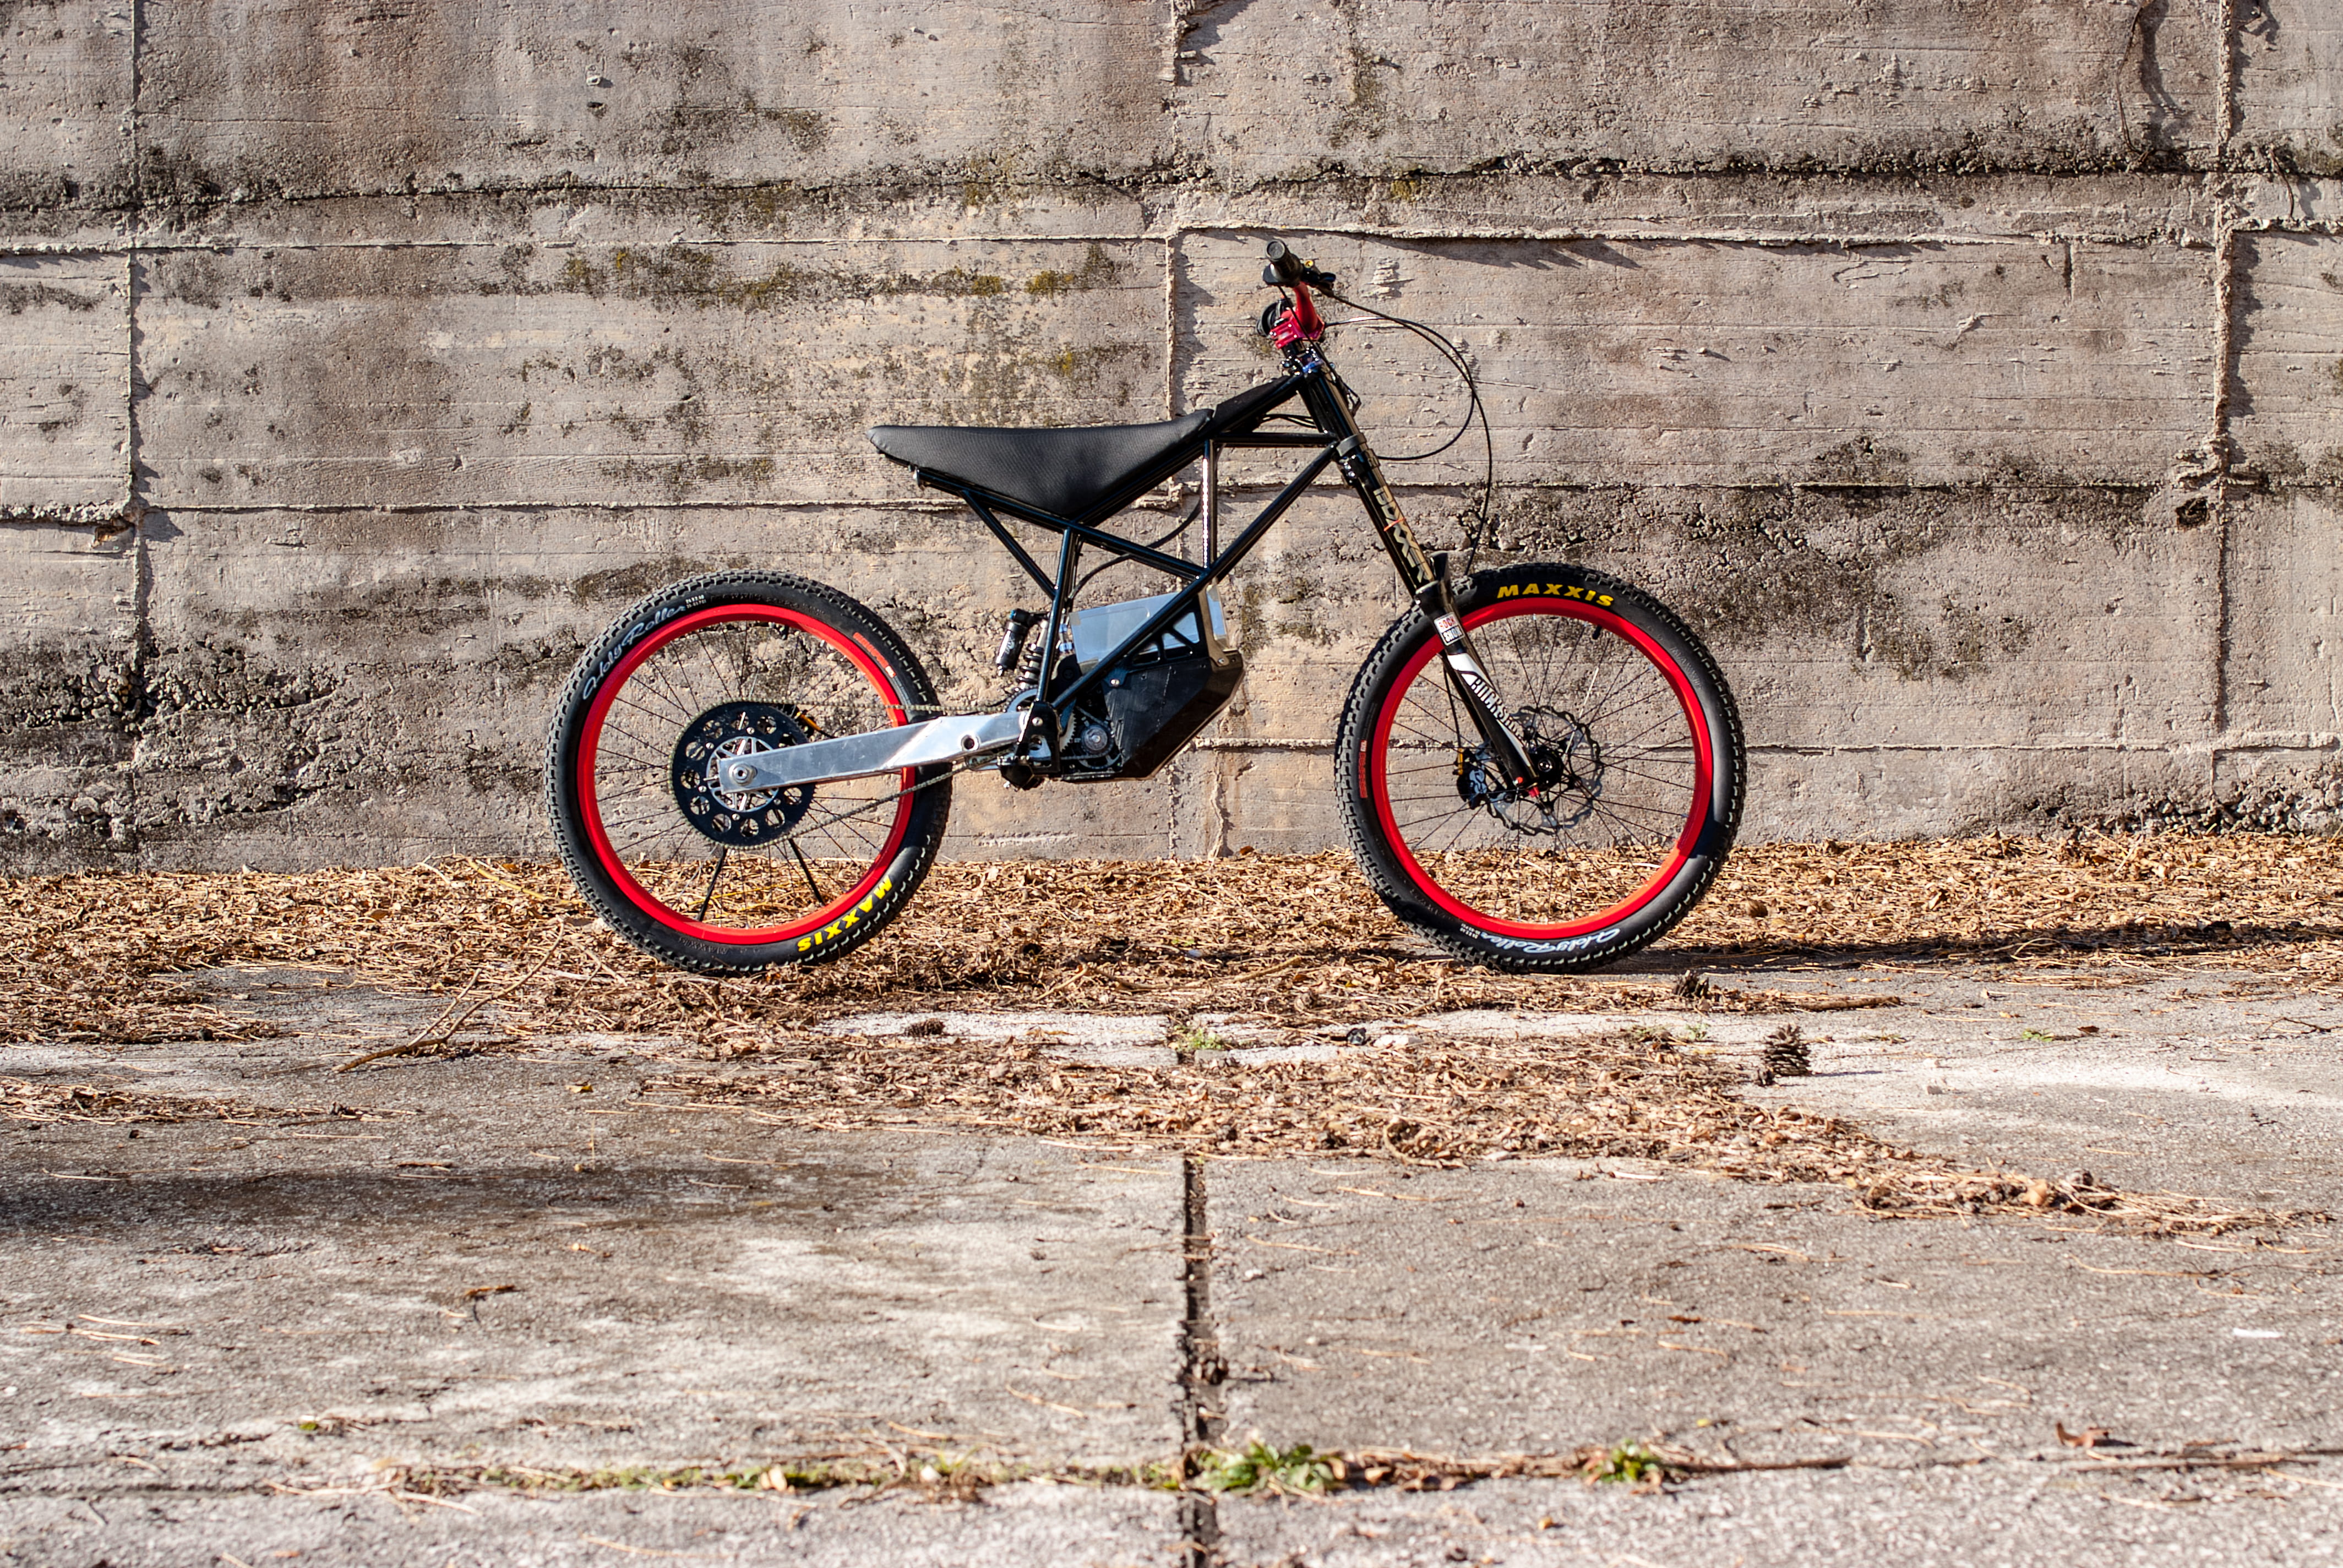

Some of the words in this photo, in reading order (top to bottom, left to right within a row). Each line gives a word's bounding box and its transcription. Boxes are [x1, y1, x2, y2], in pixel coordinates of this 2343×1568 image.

[1373, 485, 1435, 583] BOXXER
[1497, 583, 1614, 606] MAXXIS
[797, 875, 893, 952] MAXXIS
